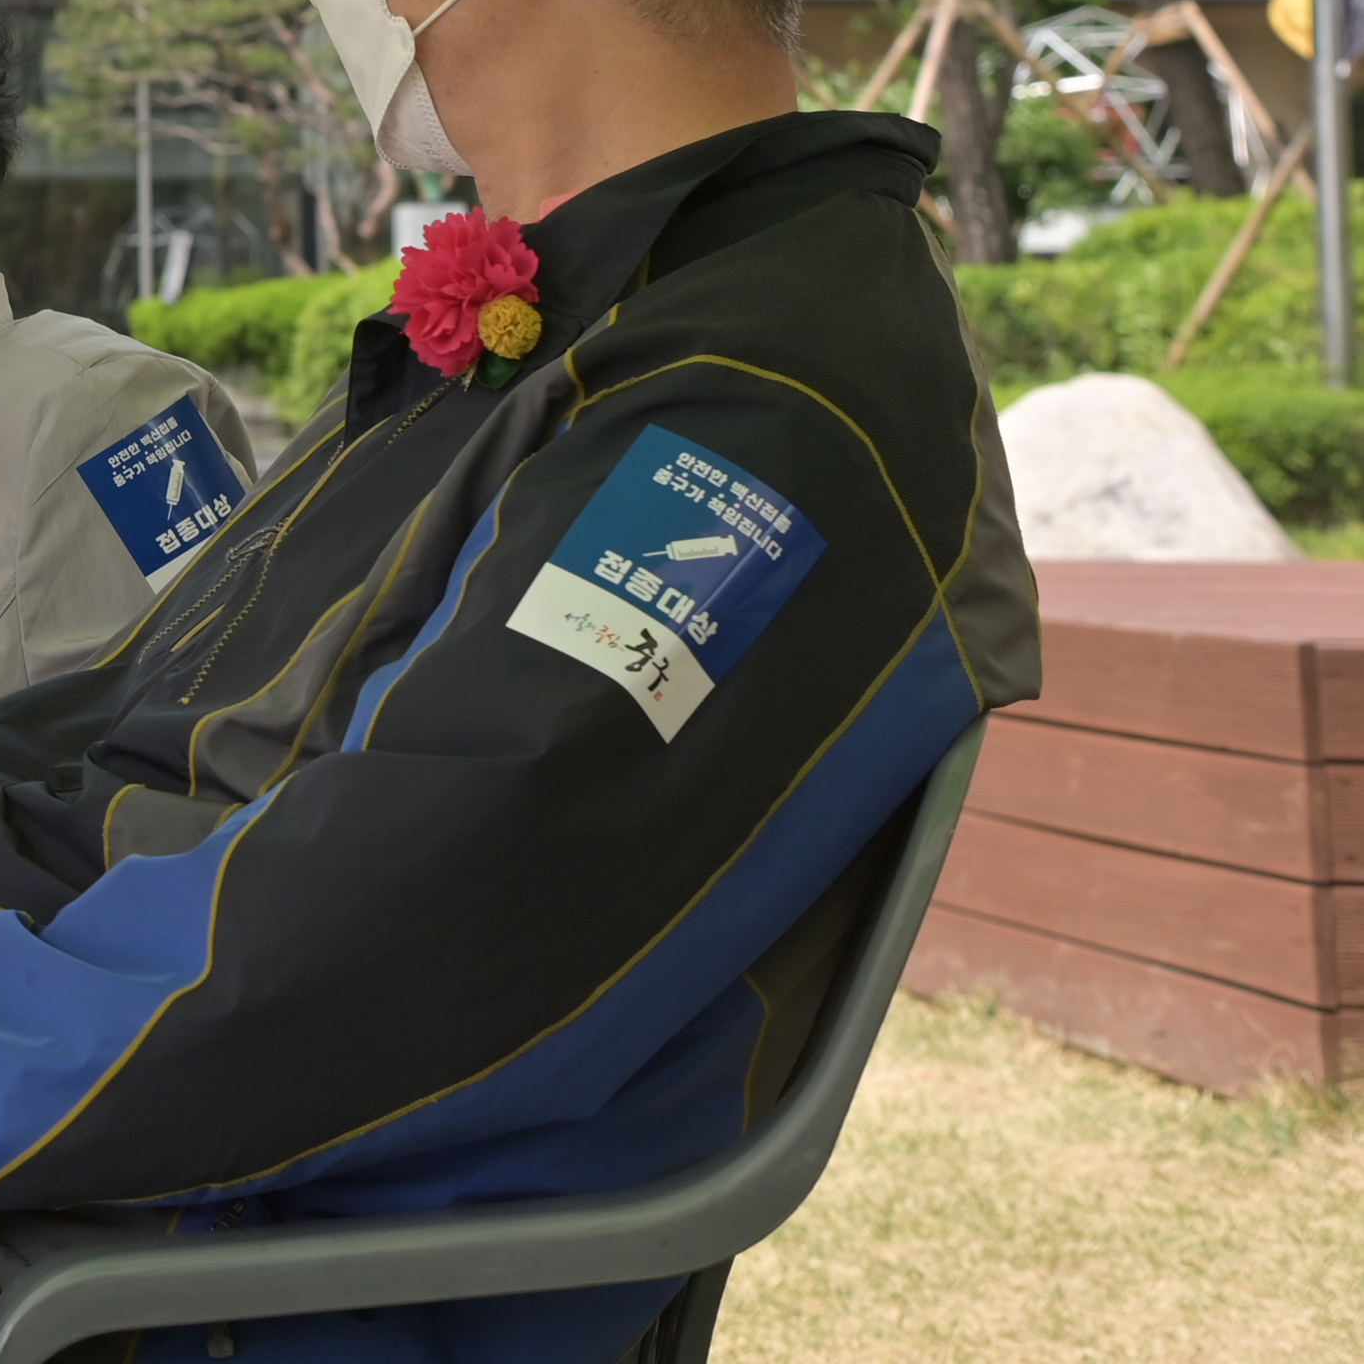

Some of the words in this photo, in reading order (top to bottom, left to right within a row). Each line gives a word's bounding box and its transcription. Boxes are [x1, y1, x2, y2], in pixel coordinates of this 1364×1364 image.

[108, 443, 141, 469] 안전한
[140, 416, 179, 447] 백신접종
[113, 461, 147, 488] 중구가
[145, 429, 193, 466] 책임집니다
[155, 493, 232, 555] 접종대상
[652, 467, 706, 504] 중구가
[707, 496, 784, 561] 책임집니다
[675, 451, 728, 488] 안전한
[730, 481, 793, 535] 백신접종
[593, 549, 720, 646] 접종대상
[624, 628, 670, 692] 중구
